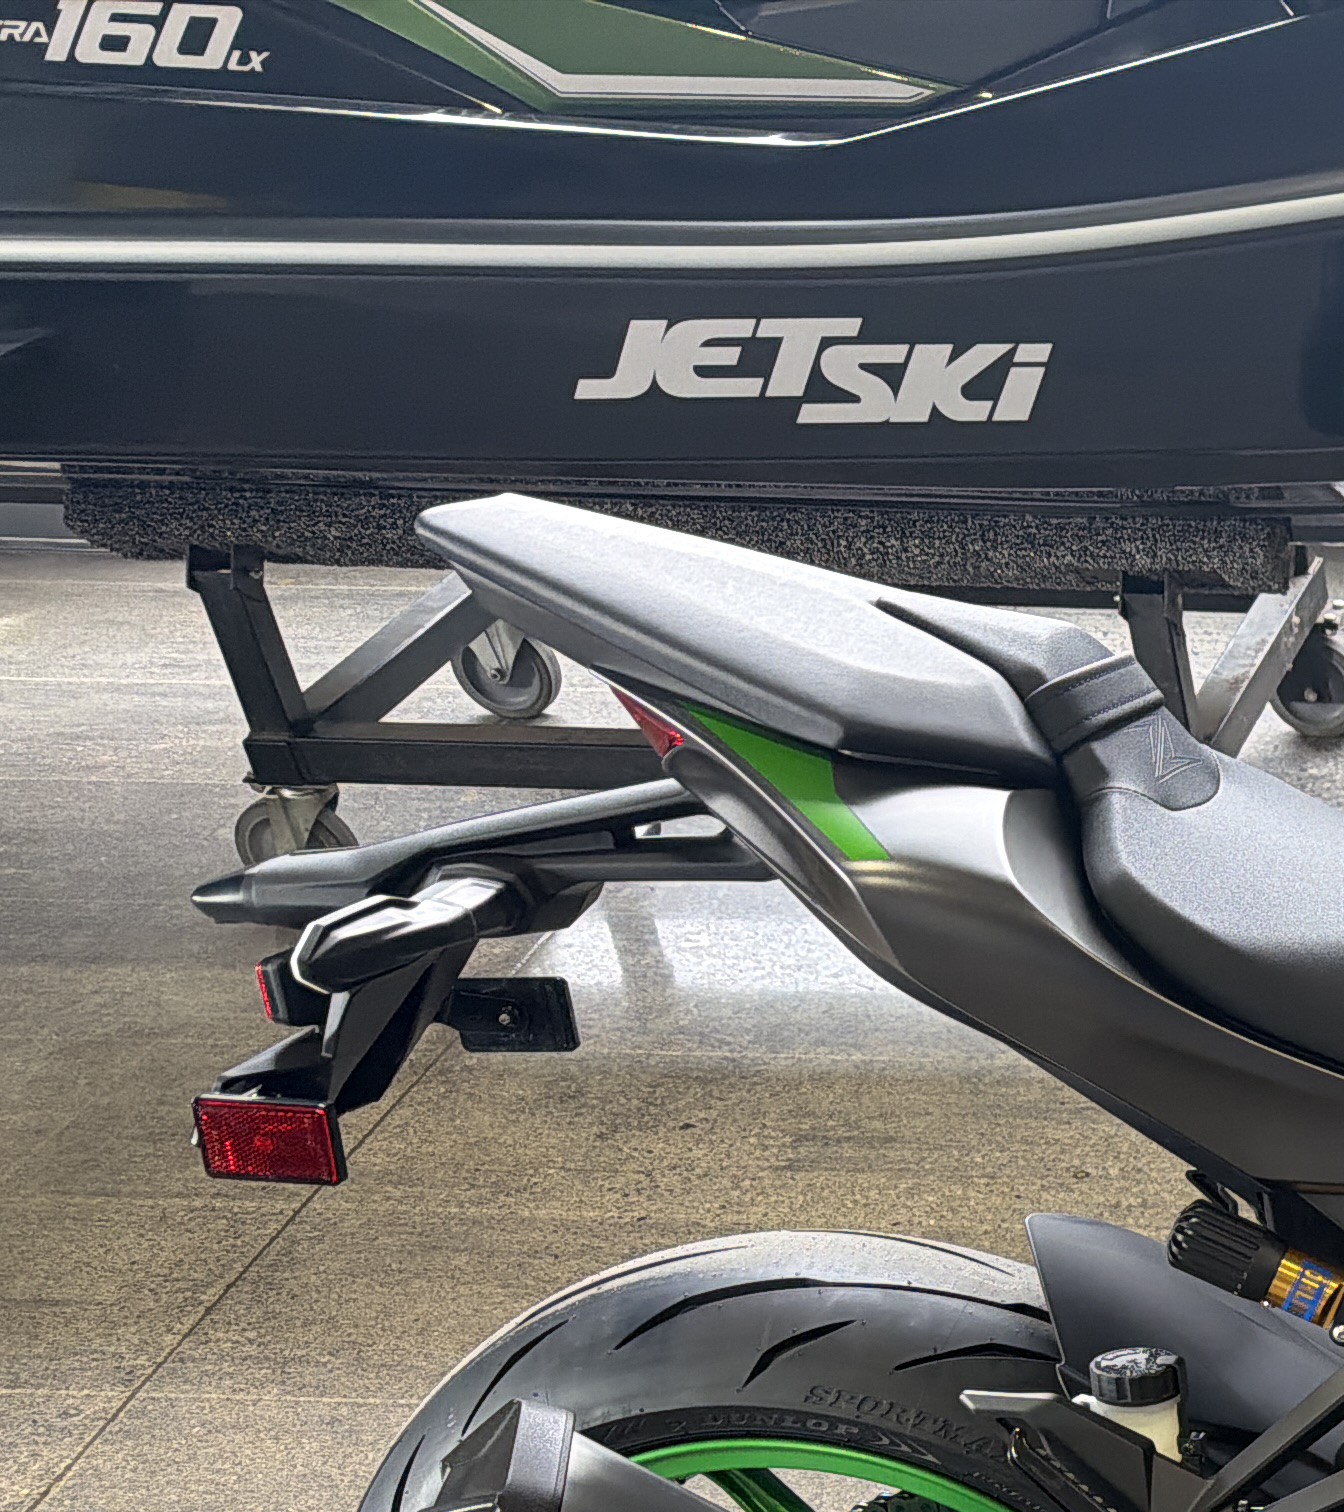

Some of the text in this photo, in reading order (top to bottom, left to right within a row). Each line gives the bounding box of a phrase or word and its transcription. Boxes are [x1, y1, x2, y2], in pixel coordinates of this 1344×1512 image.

[44, 0, 243, 70] 160
[227, 50, 270, 72] LX
[704, 1410, 860, 1437] DUNLOP
